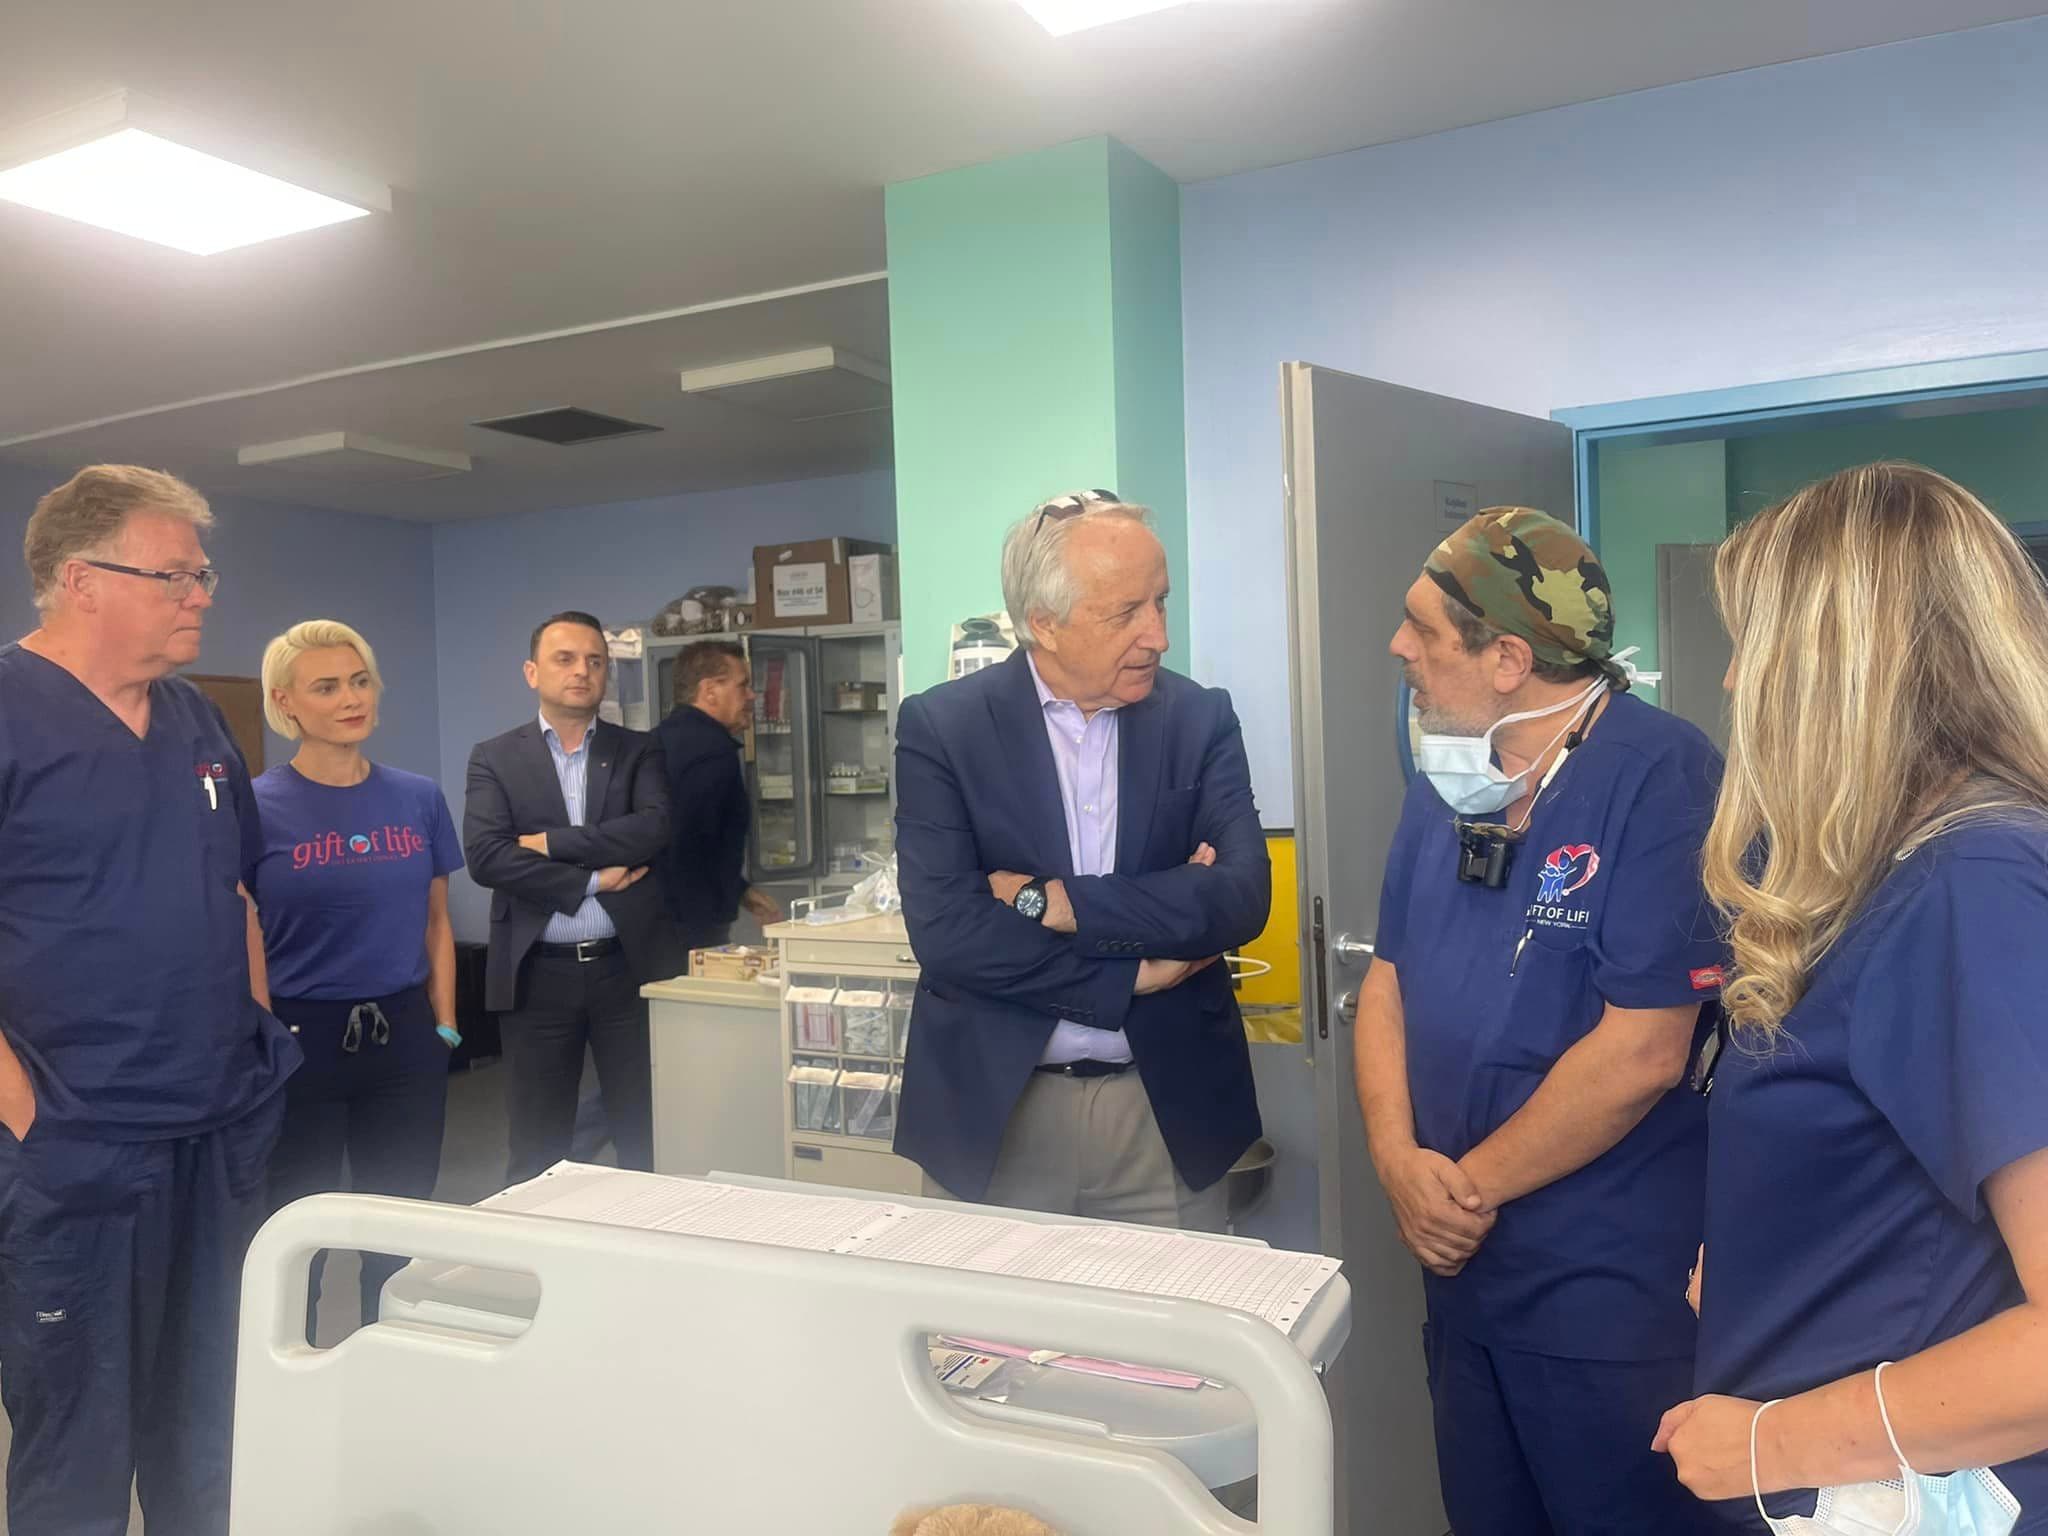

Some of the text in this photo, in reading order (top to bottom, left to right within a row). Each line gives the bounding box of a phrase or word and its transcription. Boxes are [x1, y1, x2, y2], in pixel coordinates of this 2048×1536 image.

[777, 588, 789, 596] Box
[293, 831, 344, 870] gift
[383, 824, 425, 859] life
[1546, 907, 1565, 920] OF
